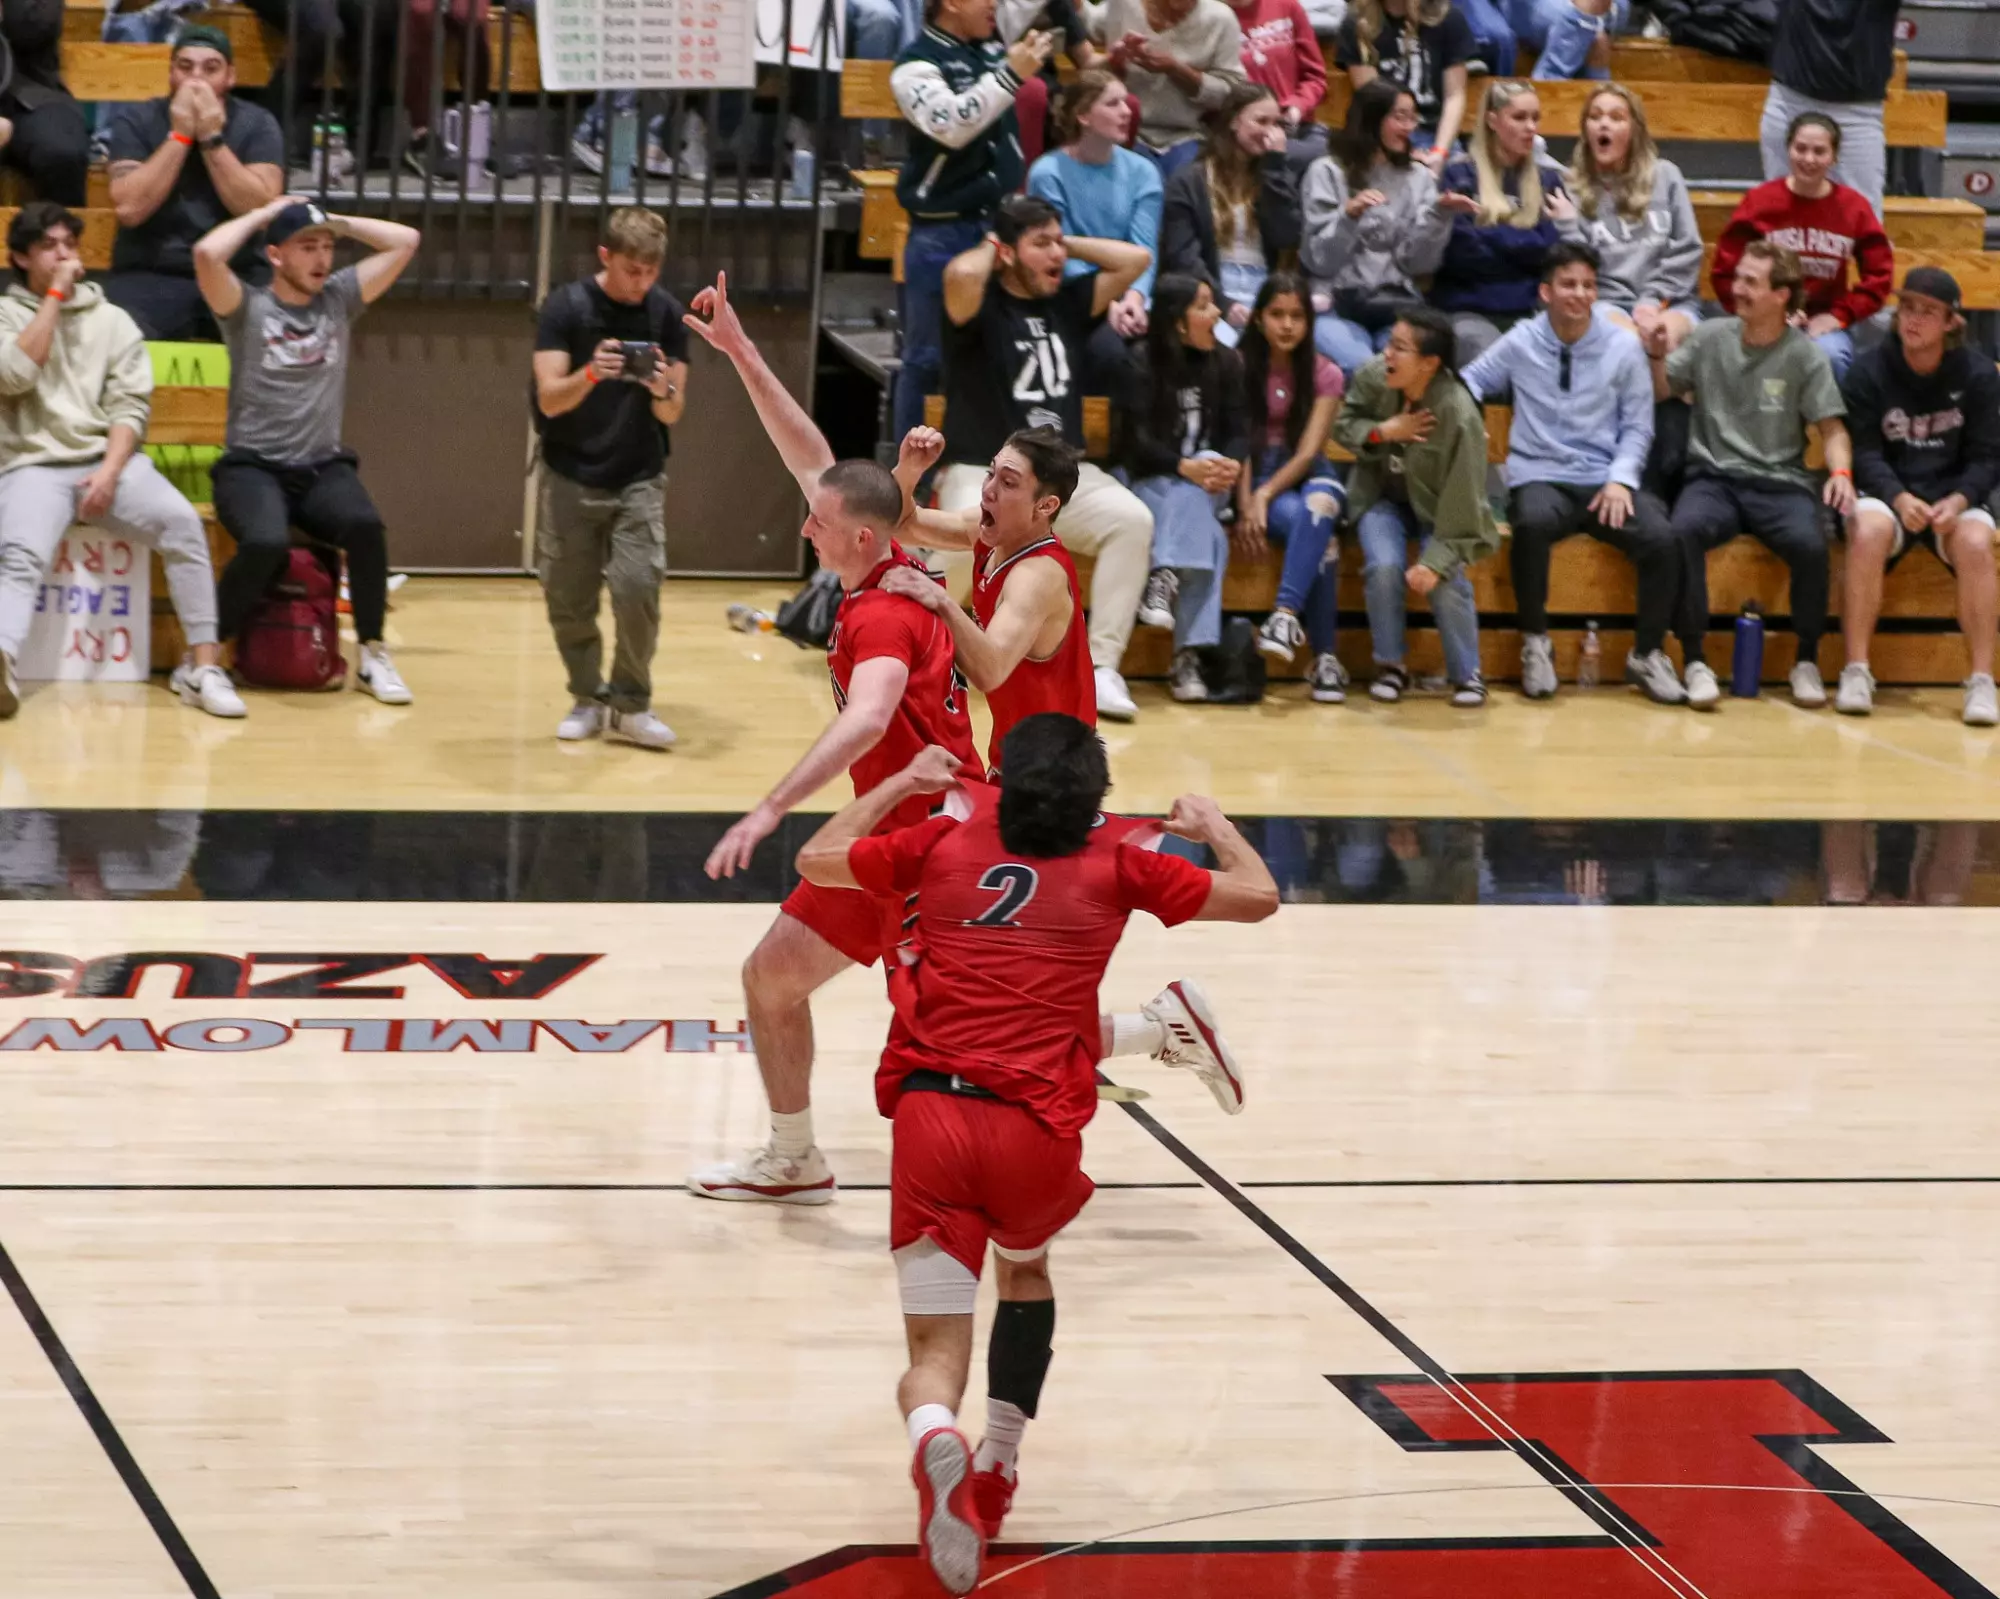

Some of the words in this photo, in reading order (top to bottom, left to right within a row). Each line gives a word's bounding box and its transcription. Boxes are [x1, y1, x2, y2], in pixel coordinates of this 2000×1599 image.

[53, 540, 133, 575] CRY
[66, 626, 132, 662] CRY
[962, 863, 1039, 928] 2
